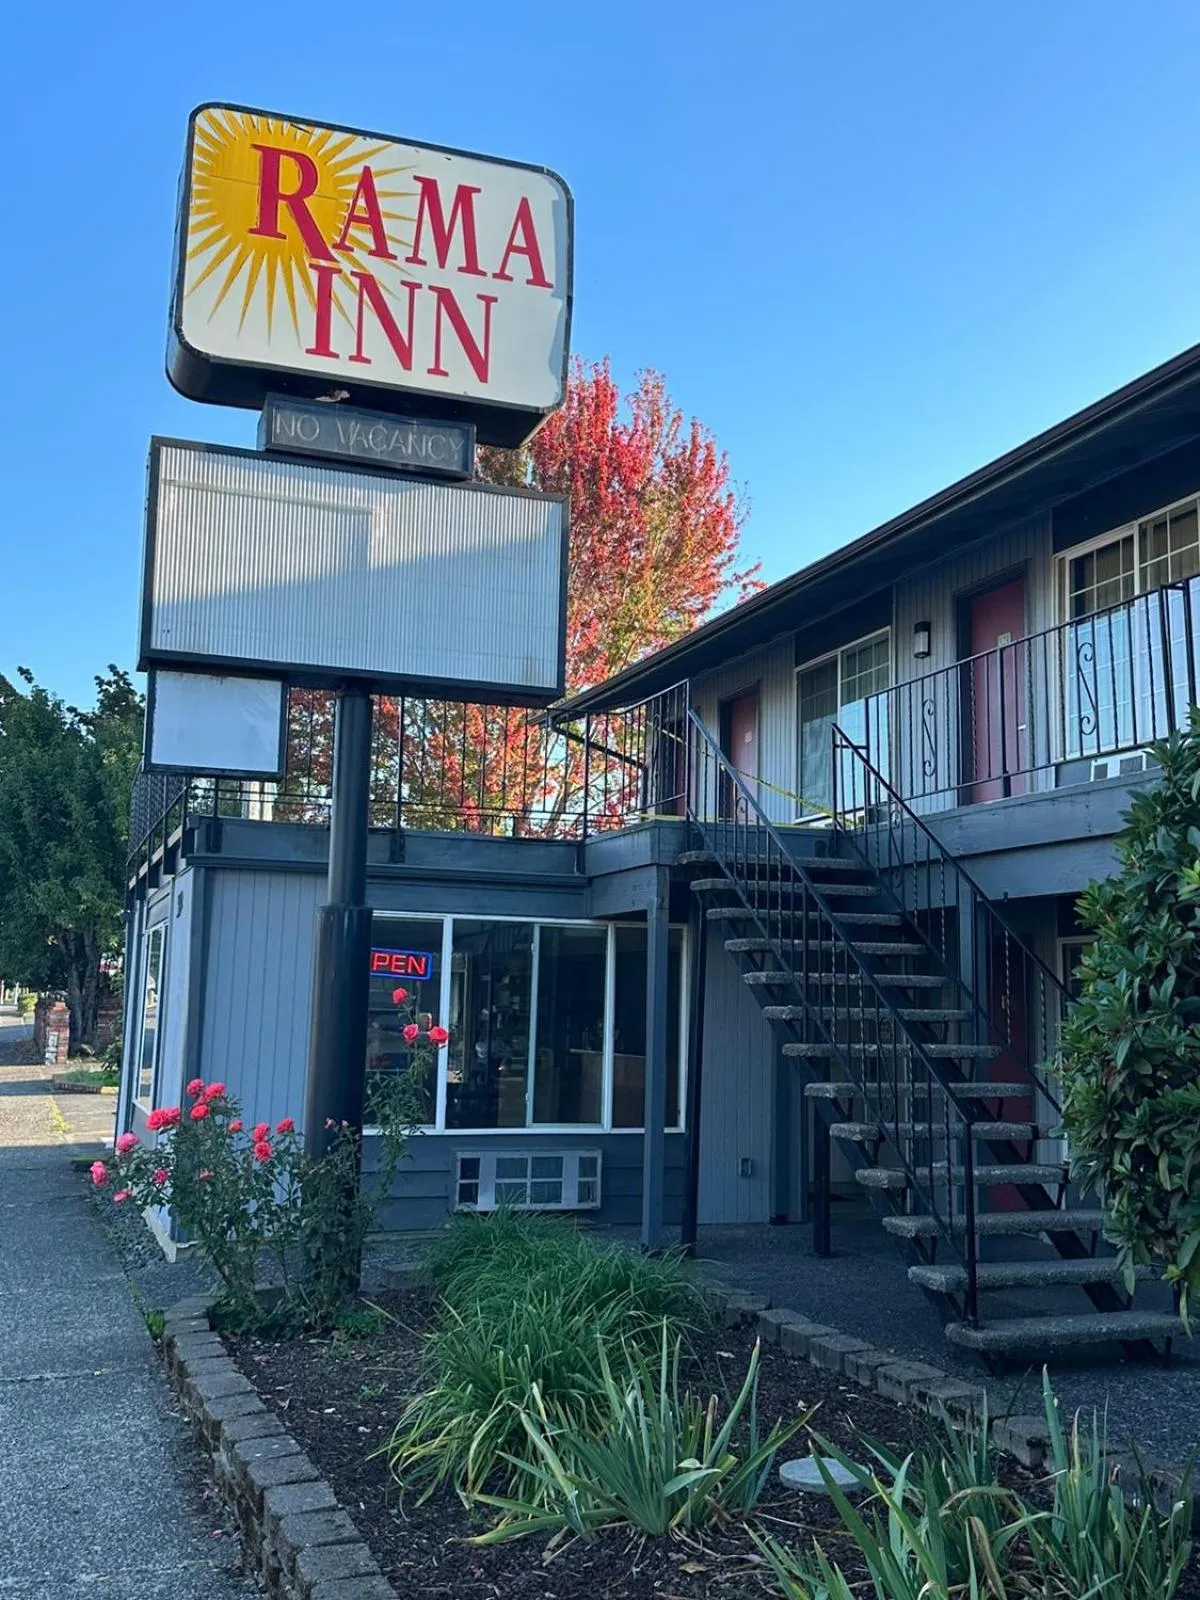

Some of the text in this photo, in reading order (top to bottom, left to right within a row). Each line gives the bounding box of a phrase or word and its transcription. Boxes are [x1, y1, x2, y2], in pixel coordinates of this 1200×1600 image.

[247, 143, 554, 289] RAMA
[304, 262, 499, 384] INN
[274, 413, 465, 462] NO VACANCY
[371, 952, 427, 975] PEN
